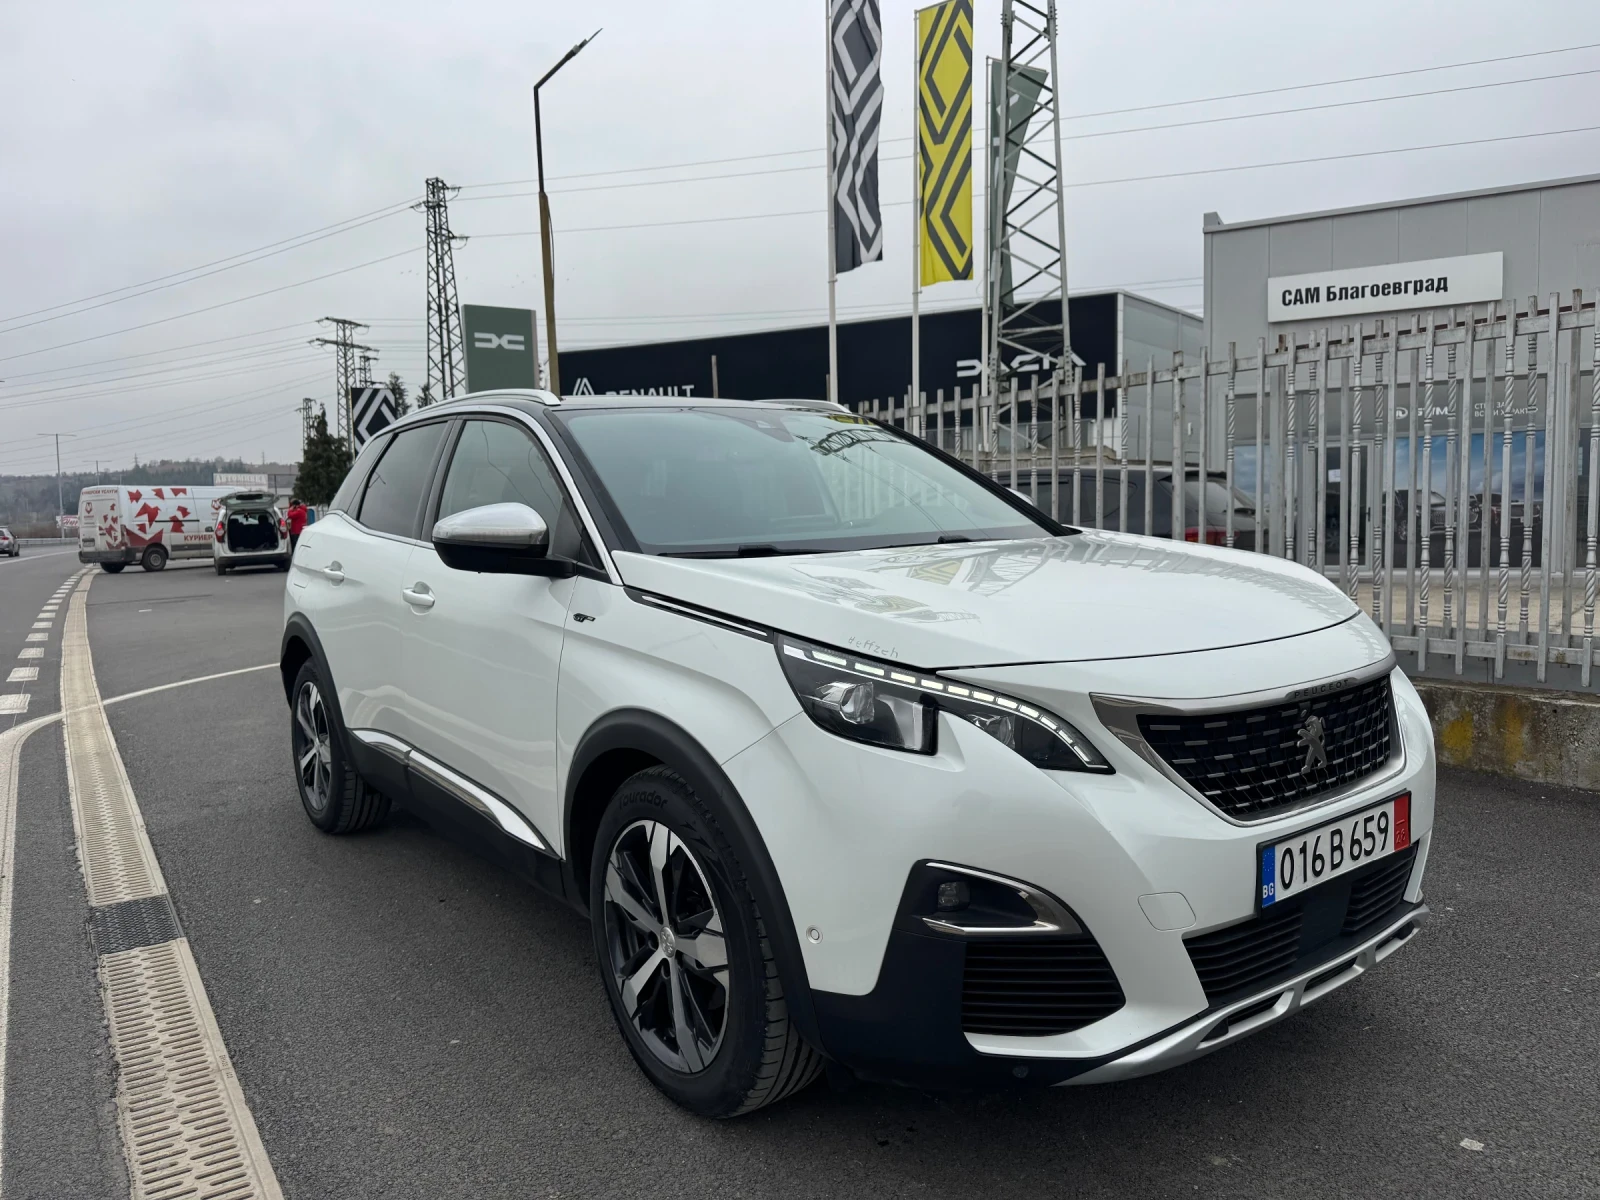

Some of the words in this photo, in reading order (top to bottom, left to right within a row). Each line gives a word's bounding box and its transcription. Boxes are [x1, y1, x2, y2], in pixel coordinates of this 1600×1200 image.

[1281, 286, 1320, 307] САМ
[1326, 276, 1449, 302] Благоевград
[956, 353, 1087, 378] DCI
[605, 384, 695, 398] NAULT
[1417, 406, 1449, 417] GM
[1294, 679, 1349, 699] PEUGEOT
[1262, 882, 1275, 899] BG
